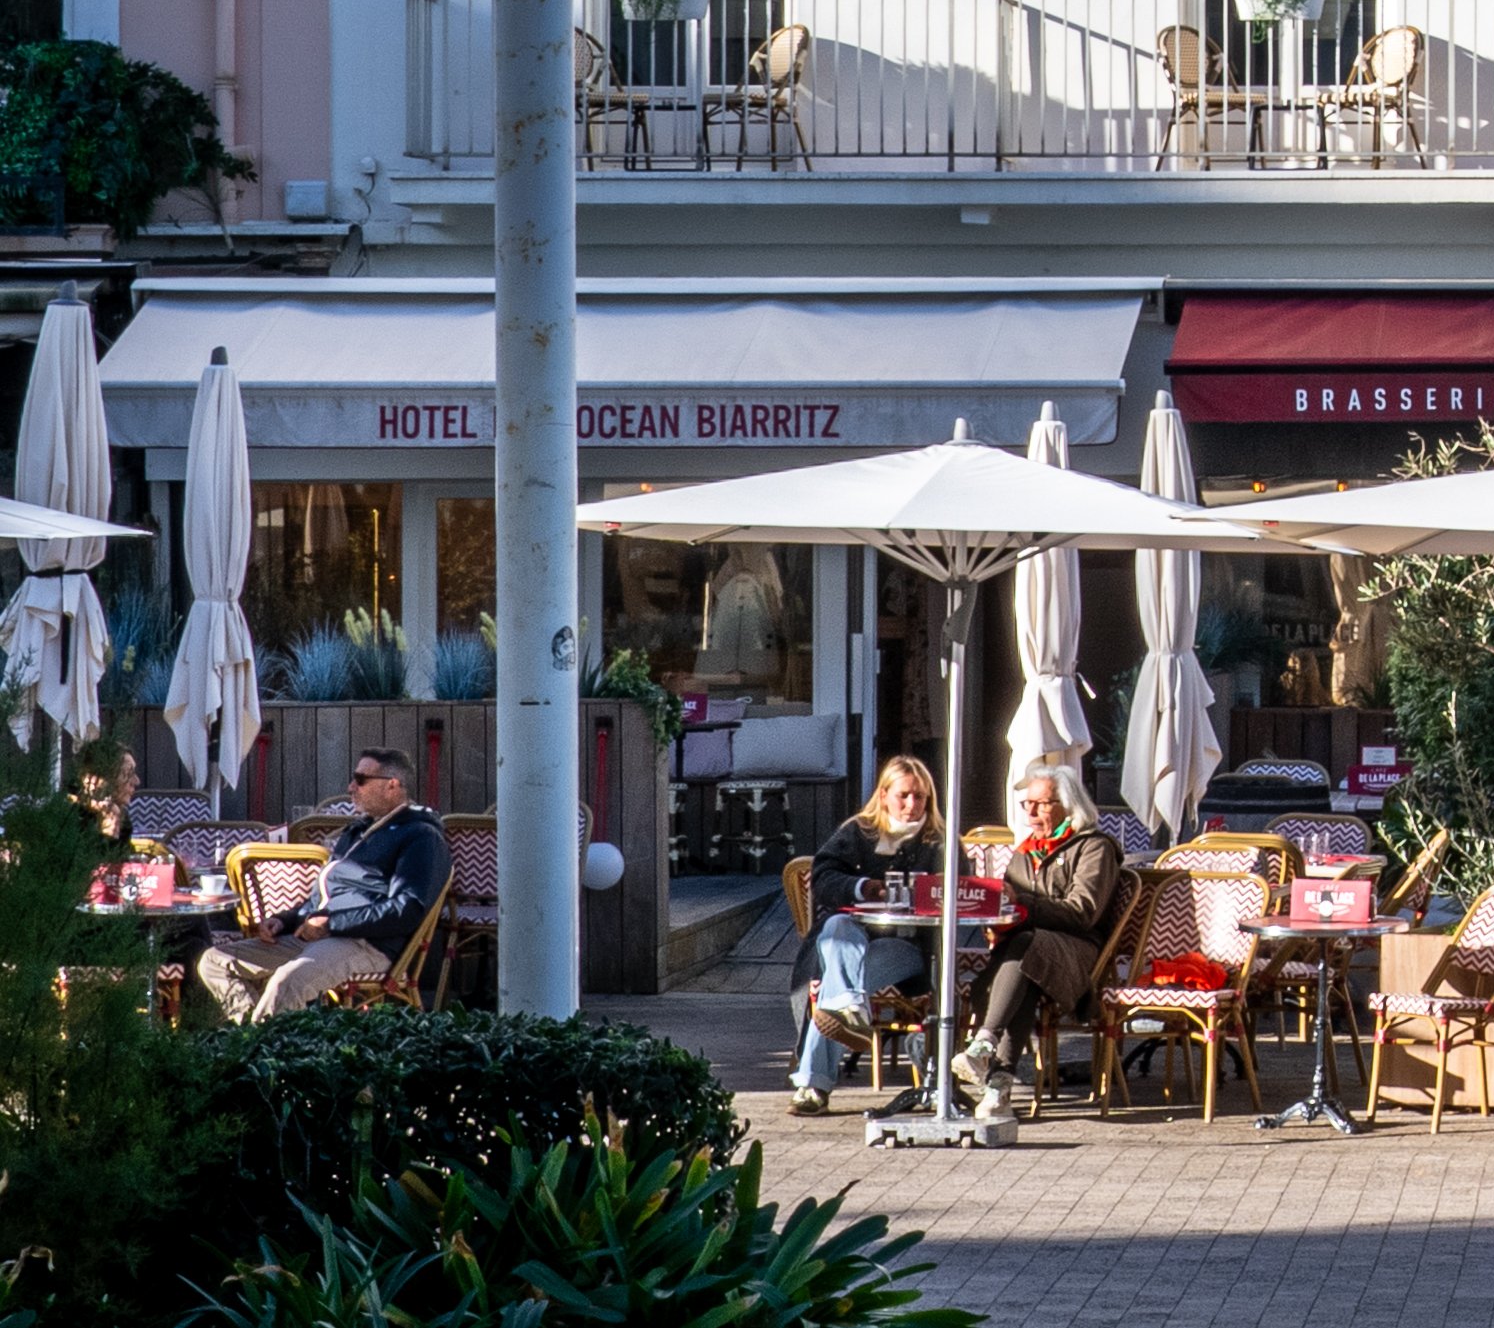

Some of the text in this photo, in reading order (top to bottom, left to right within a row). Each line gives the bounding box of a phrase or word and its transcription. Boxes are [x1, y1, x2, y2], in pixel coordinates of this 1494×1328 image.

[378, 405, 477, 439] HOTEL
[697, 404, 840, 439] BIARRITZ
[1368, 773, 1378, 783] LA
[1379, 773, 1401, 783] PLACE
[931, 886, 986, 901] DE PLACE
